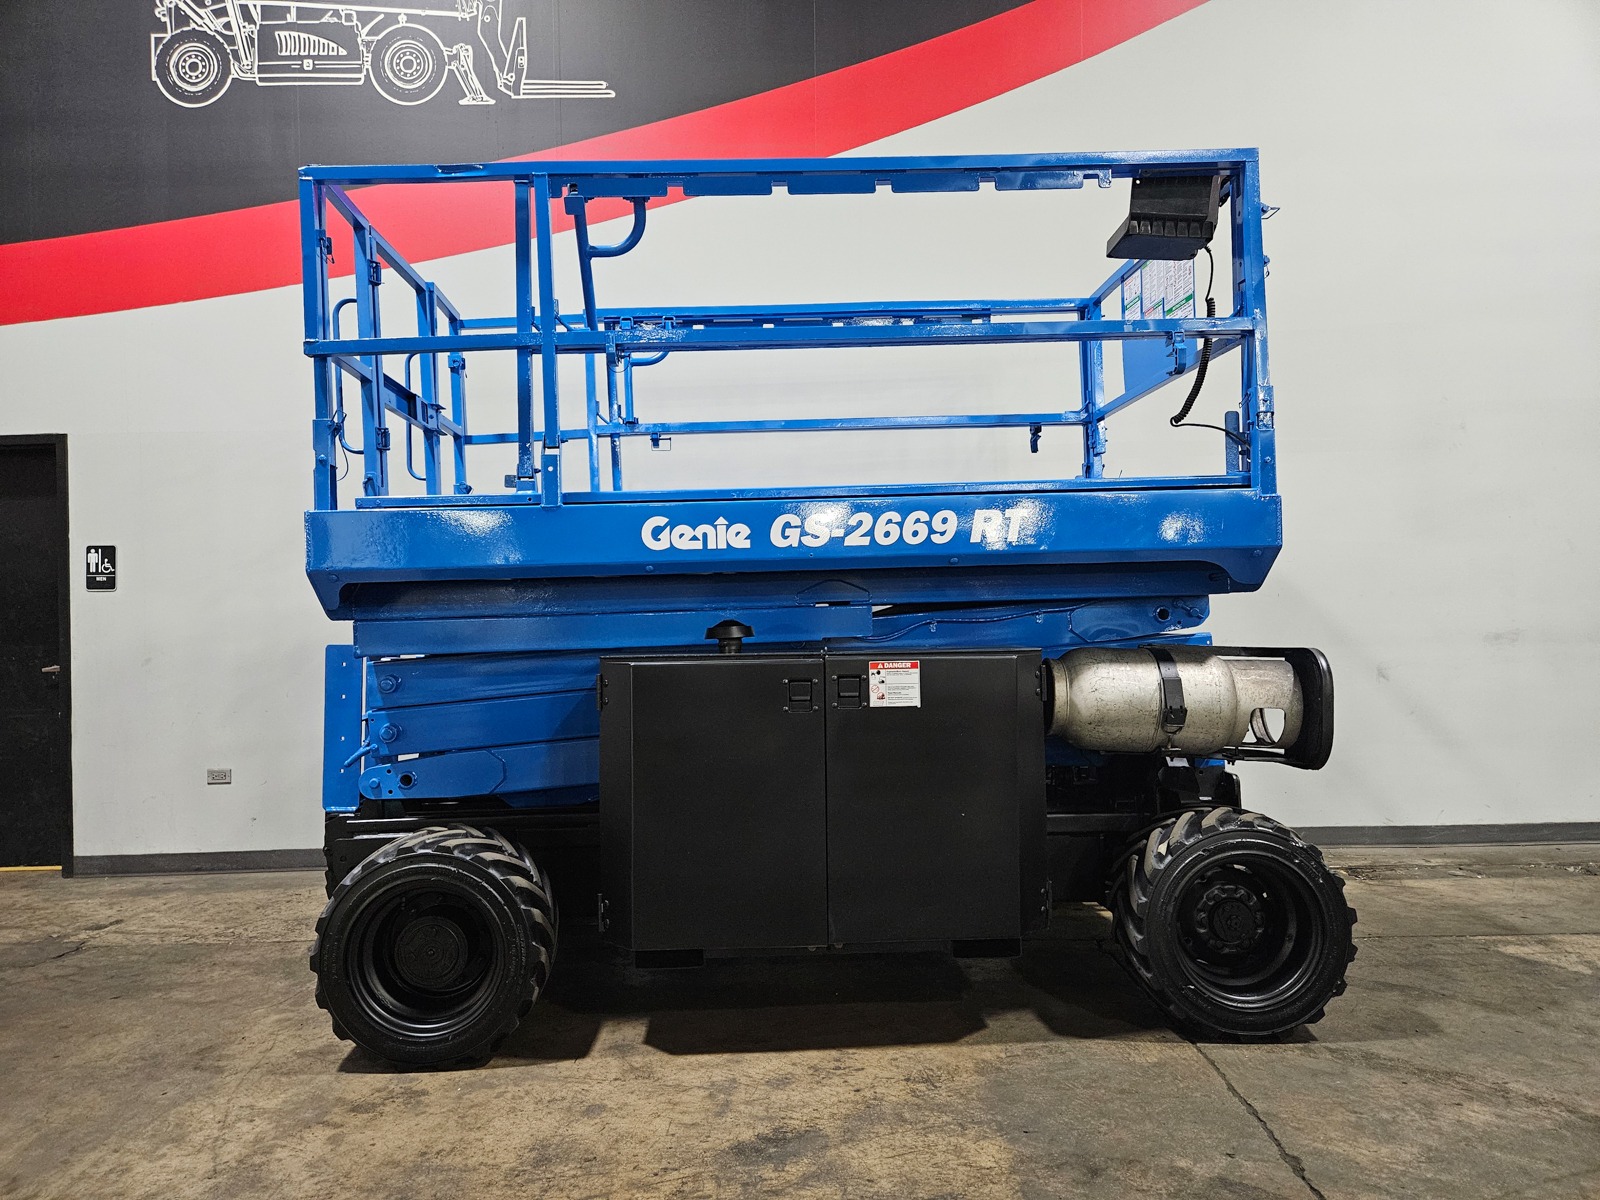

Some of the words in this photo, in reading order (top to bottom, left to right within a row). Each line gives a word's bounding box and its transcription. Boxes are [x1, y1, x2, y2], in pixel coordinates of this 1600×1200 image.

[641, 515, 751, 551] Genie
[769, 509, 958, 548] GS-2669
[969, 508, 1029, 543] RT
